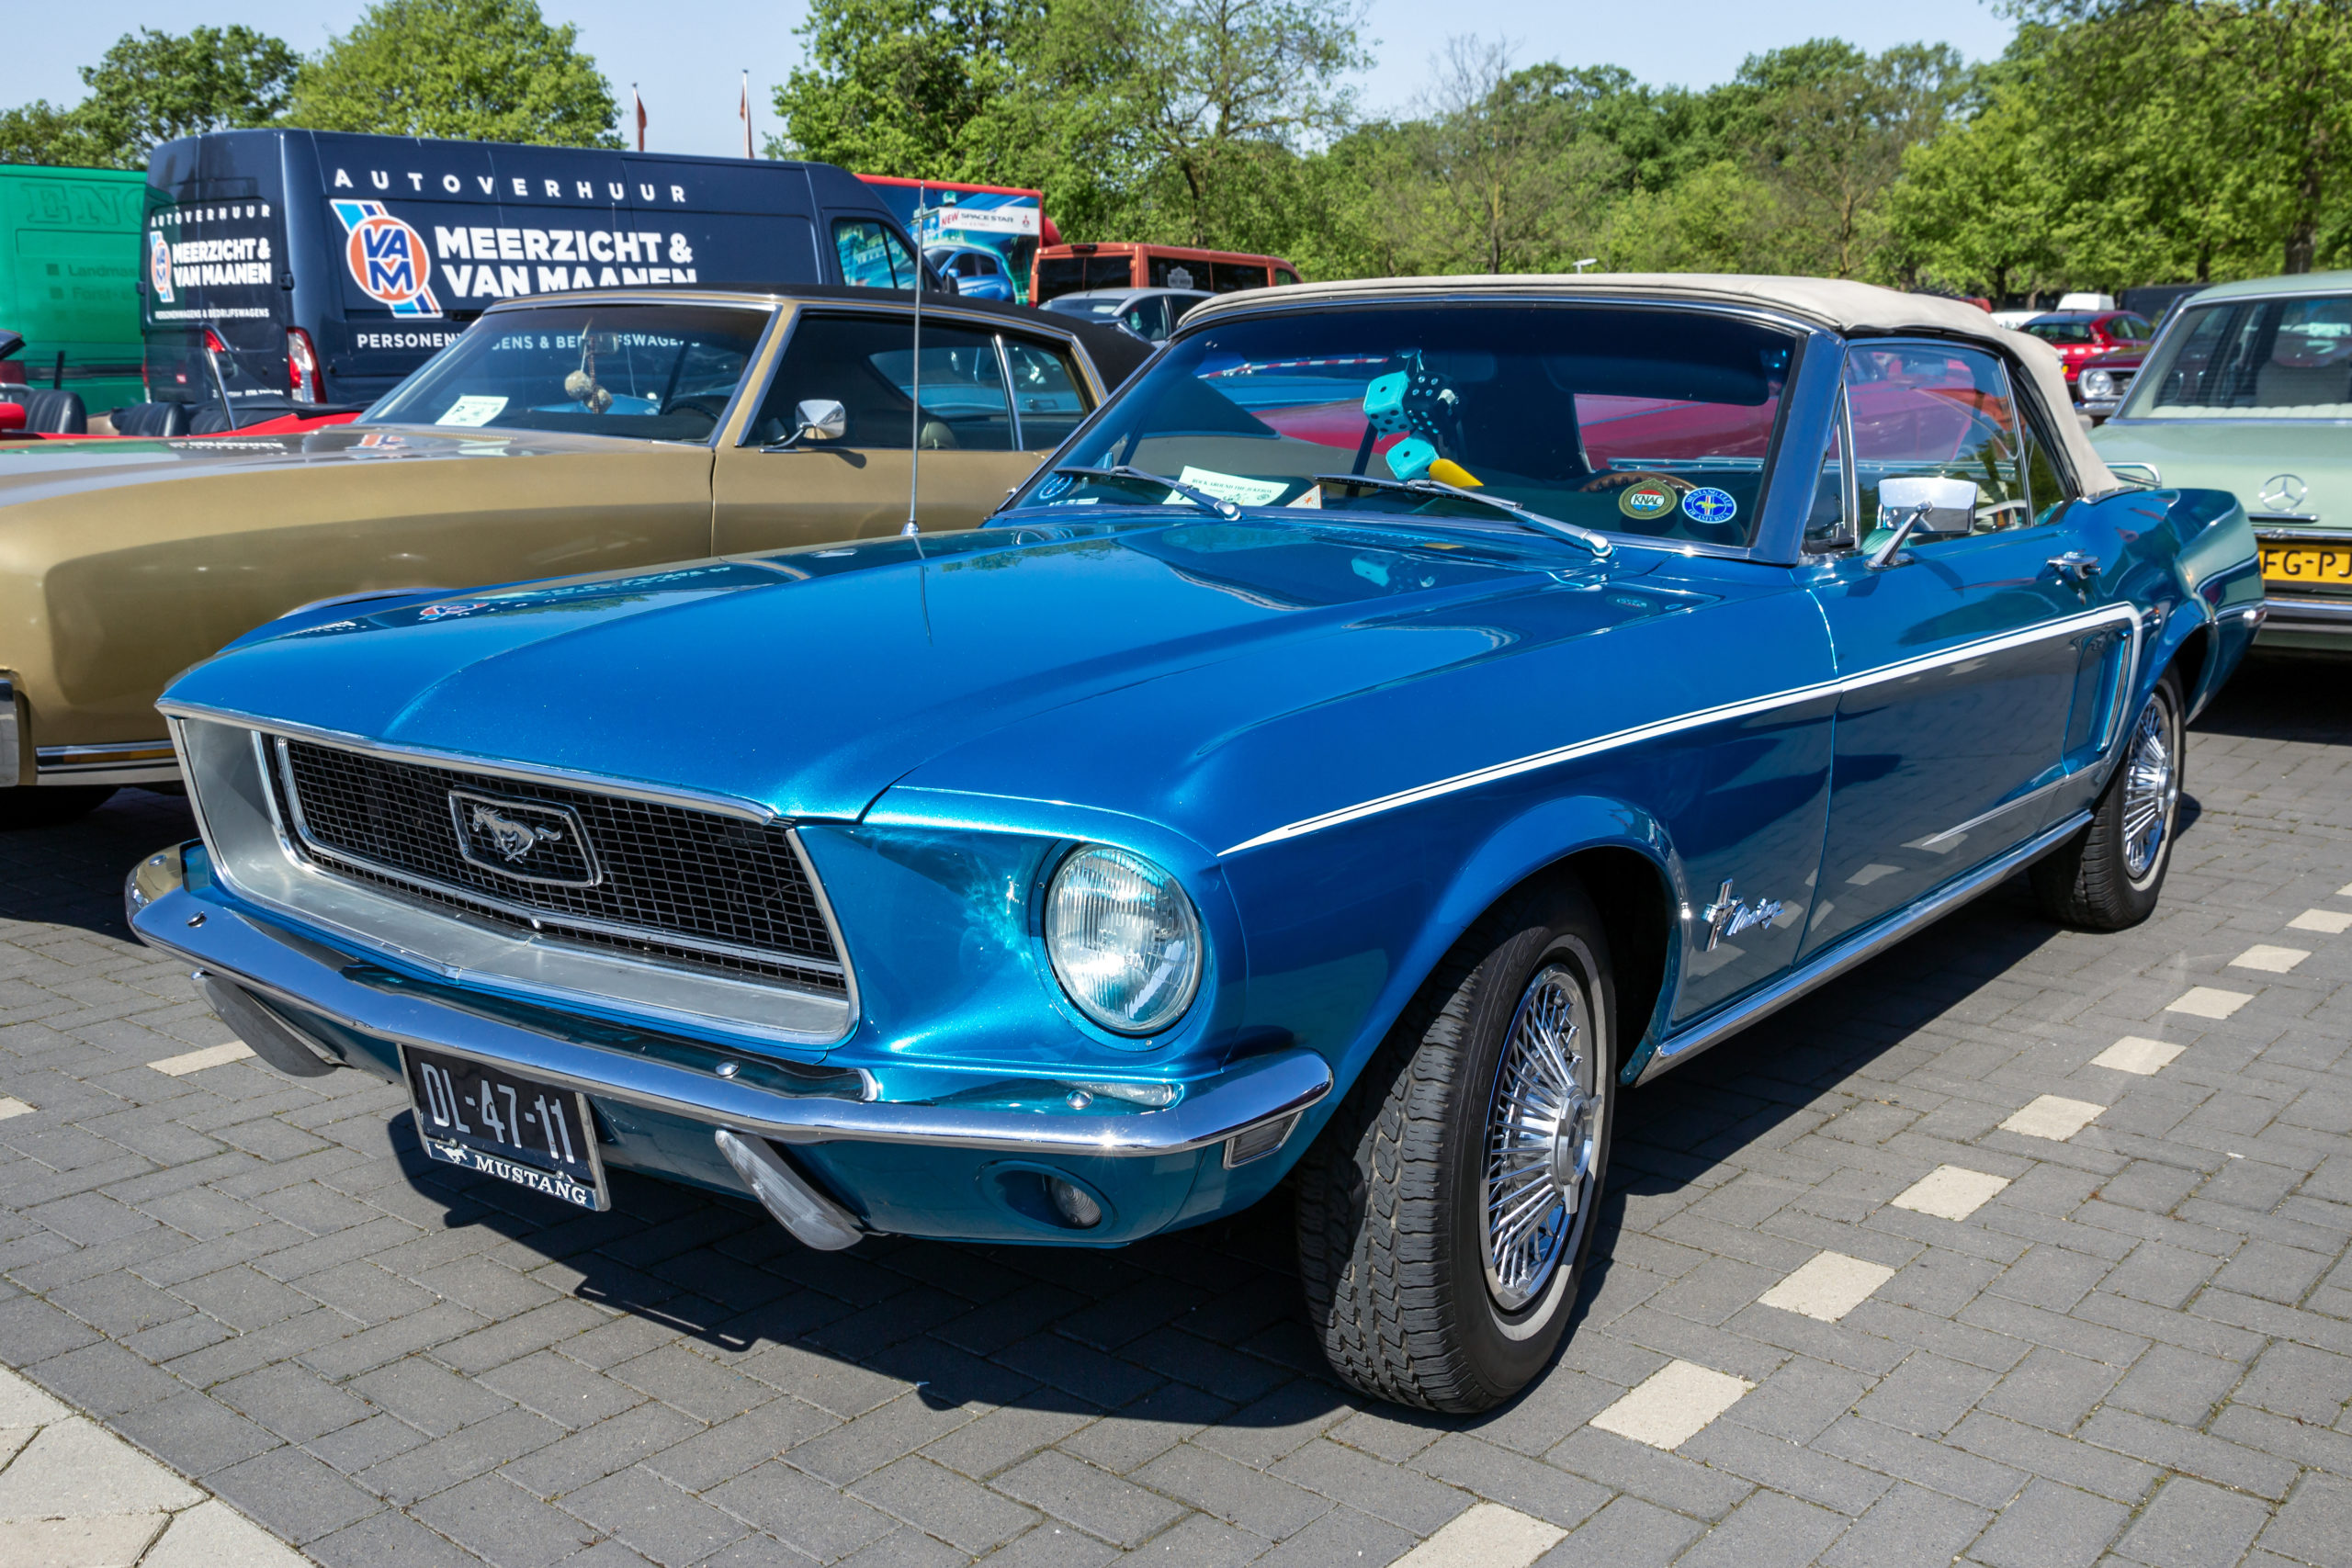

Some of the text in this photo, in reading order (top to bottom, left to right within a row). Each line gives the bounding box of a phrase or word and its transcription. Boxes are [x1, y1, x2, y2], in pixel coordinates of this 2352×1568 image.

[334, 168, 686, 203] AUTOVERHUUR
[151, 204, 270, 228] AUTOVERHUUR
[941, 210, 959, 226] NEW
[991, 215, 1014, 223] STAR
[172, 237, 271, 265] MEERZICHT &
[435, 226, 693, 264] MEERZICHT &
[173, 262, 272, 288] VAN MAANEN
[441, 265, 531, 298] VAN
[208, 308, 270, 318] BEDRIJFSWAGENS
[539, 335, 549, 349] &
[1634, 494, 1664, 505] KNAC
[2263, 548, 2352, 577] FG-PJ
[421, 1062, 575, 1164] DL-47-11
[474, 1154, 587, 1205] MUSTANG
